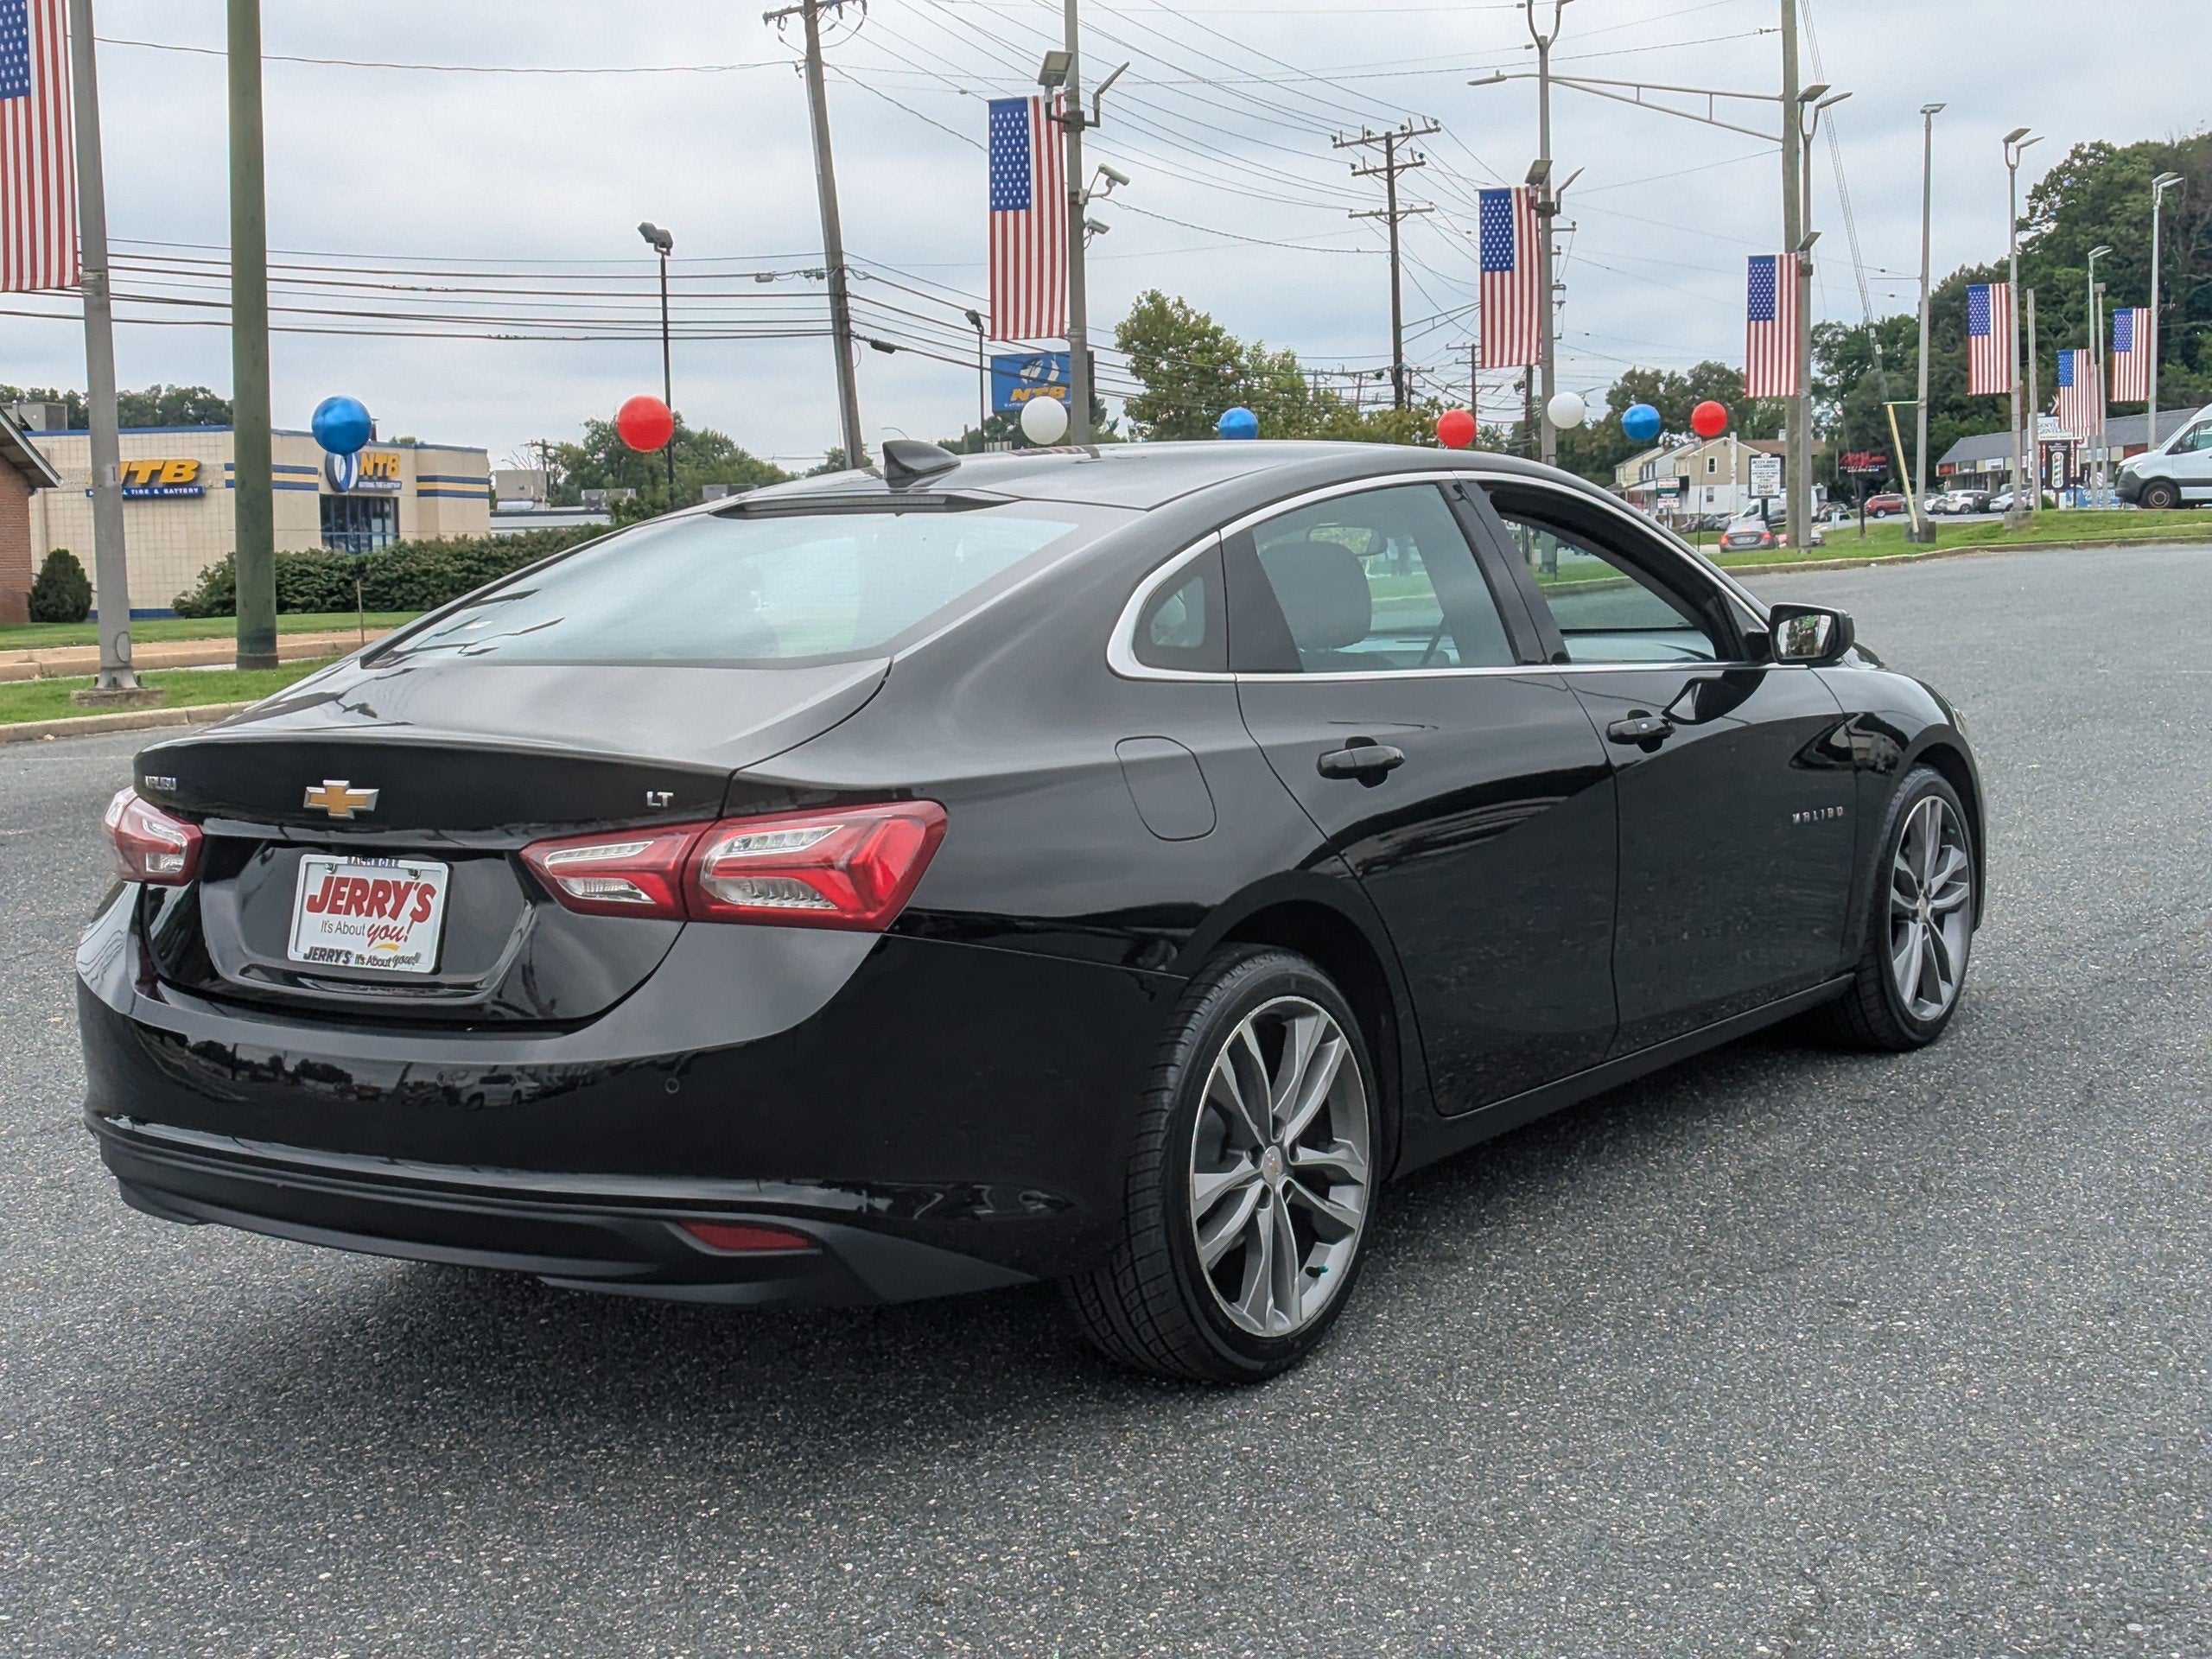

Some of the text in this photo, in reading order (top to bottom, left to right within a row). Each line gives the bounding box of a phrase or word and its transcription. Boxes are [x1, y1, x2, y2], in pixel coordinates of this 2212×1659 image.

[359, 451, 400, 477] NTB
[646, 791, 674, 807] LT
[1792, 806, 1843, 824] MALIBU
[306, 875, 437, 923] JERRY'S
[321, 920, 415, 948] It's About you!
[303, 946, 352, 964] JERRY'S
[354, 953, 365, 966] It's
[365, 955, 391, 969] About
